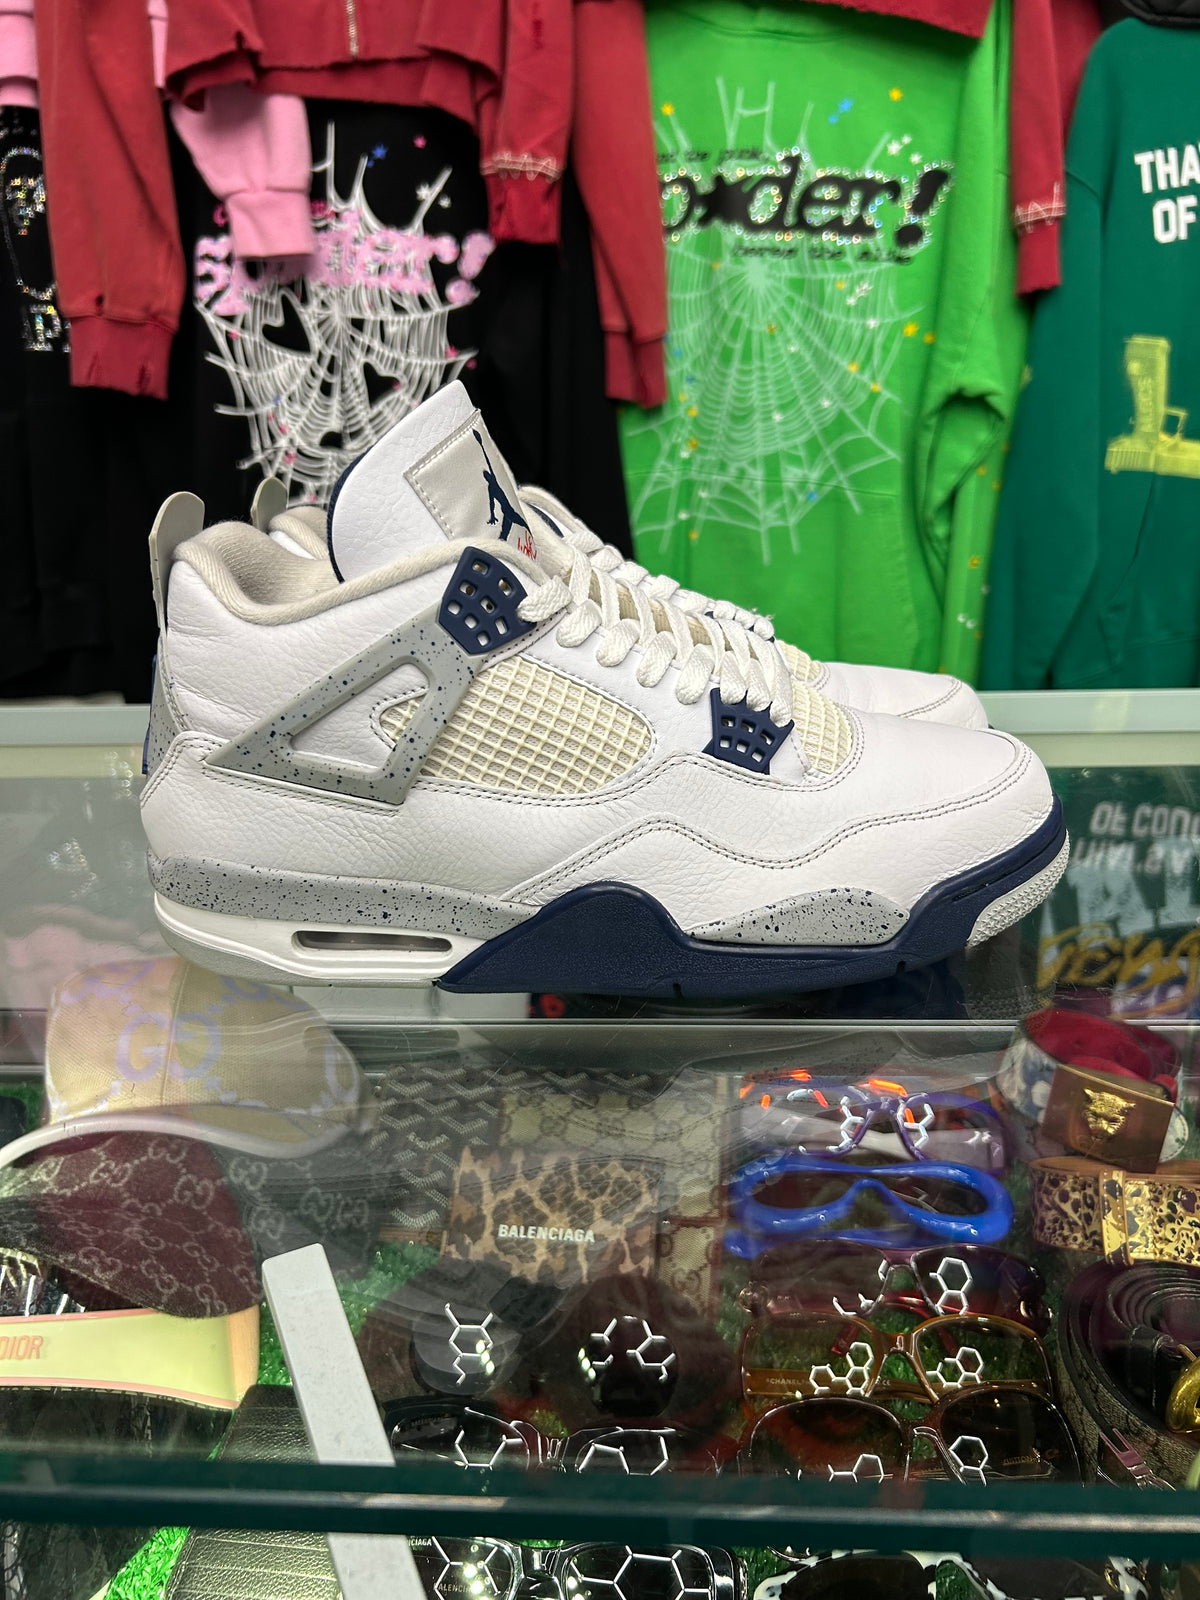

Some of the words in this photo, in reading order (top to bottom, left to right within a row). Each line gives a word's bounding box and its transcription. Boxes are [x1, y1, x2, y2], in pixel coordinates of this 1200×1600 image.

[1134, 142, 1200, 194] THA
[1152, 194, 1198, 244] OF
[498, 1224, 595, 1243] BALENCIAGA
